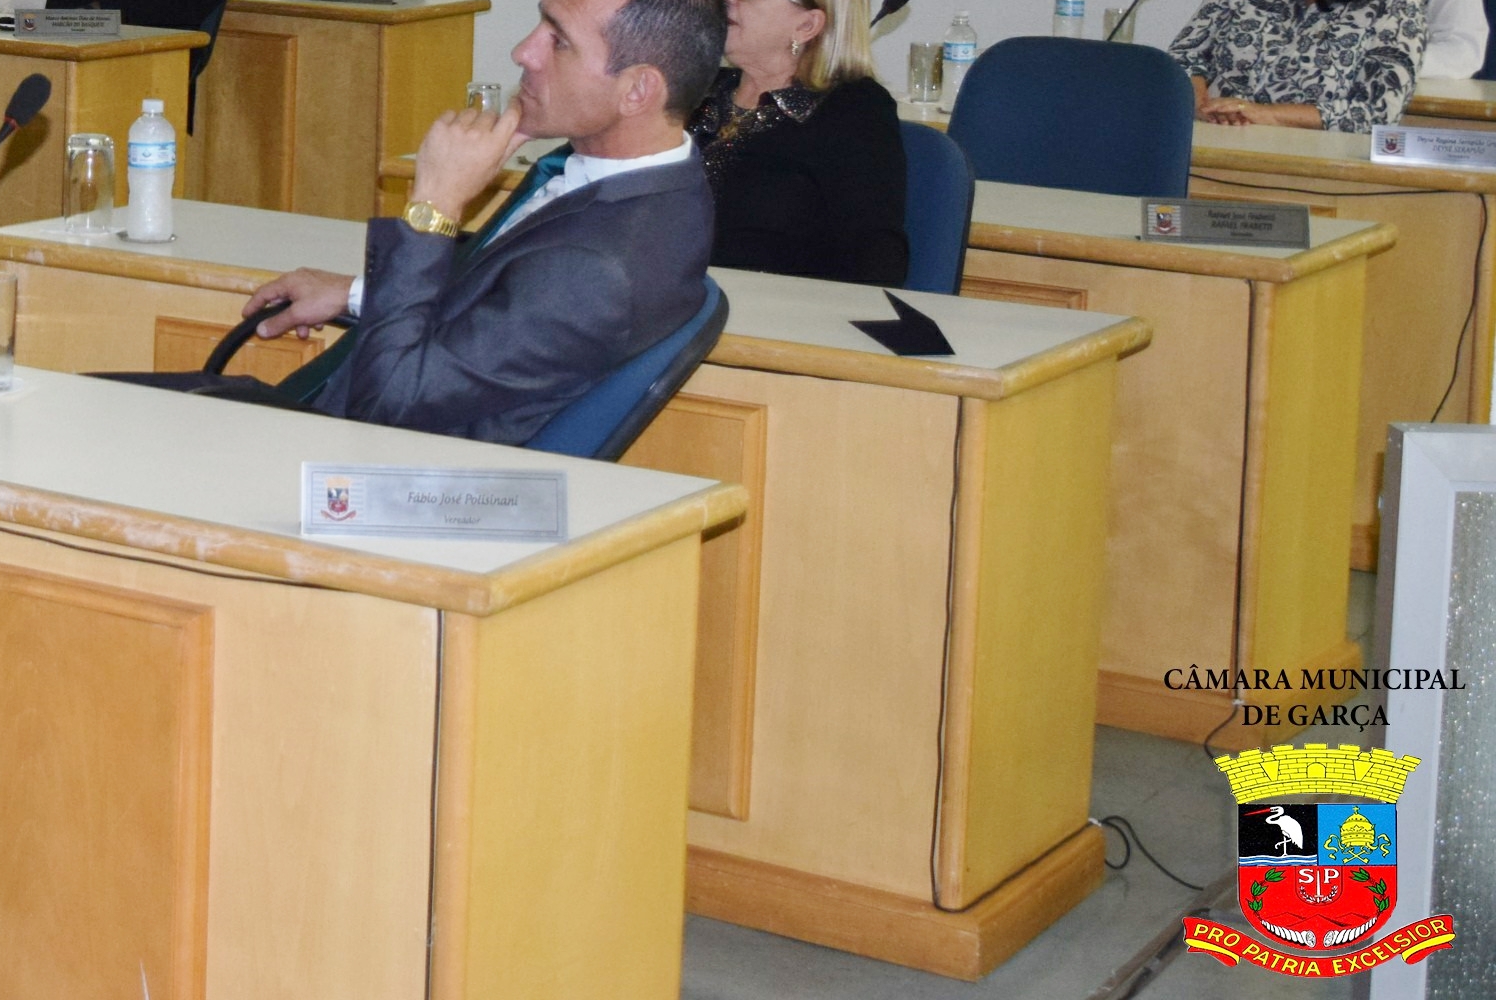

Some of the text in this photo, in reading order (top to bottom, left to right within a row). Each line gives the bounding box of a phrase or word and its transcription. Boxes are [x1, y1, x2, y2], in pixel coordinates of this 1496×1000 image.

[407, 491, 438, 504] Fábio
[439, 492, 462, 506] José
[444, 515, 481, 524] Vereador
